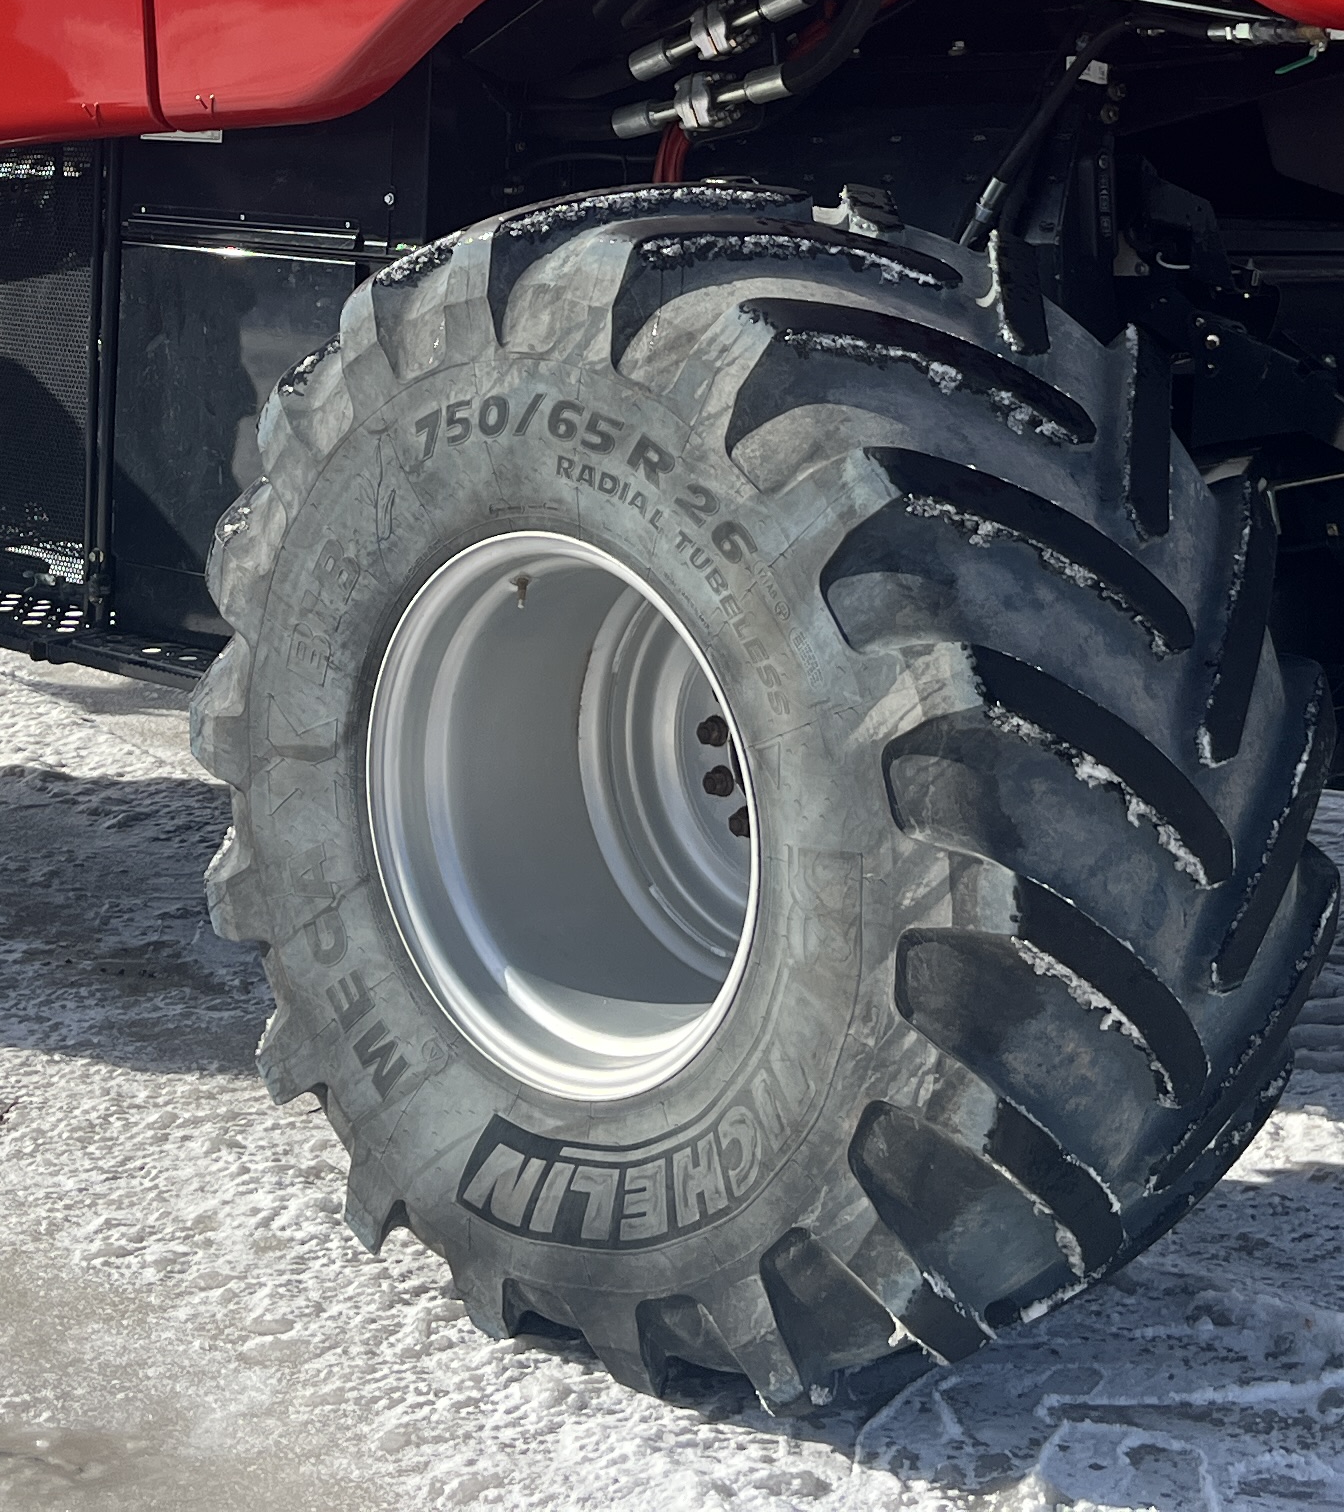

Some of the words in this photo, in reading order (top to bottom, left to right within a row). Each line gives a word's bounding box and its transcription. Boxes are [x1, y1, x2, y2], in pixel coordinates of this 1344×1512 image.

[414, 392, 625, 462] 750/65
[626, 433, 676, 488] R
[673, 482, 759, 565] 26
[556, 454, 665, 536] RADIAL
[674, 530, 791, 716] TUBELESS
[287, 842, 410, 1102] MEGA
[461, 1013, 821, 1242] MICHELIN
